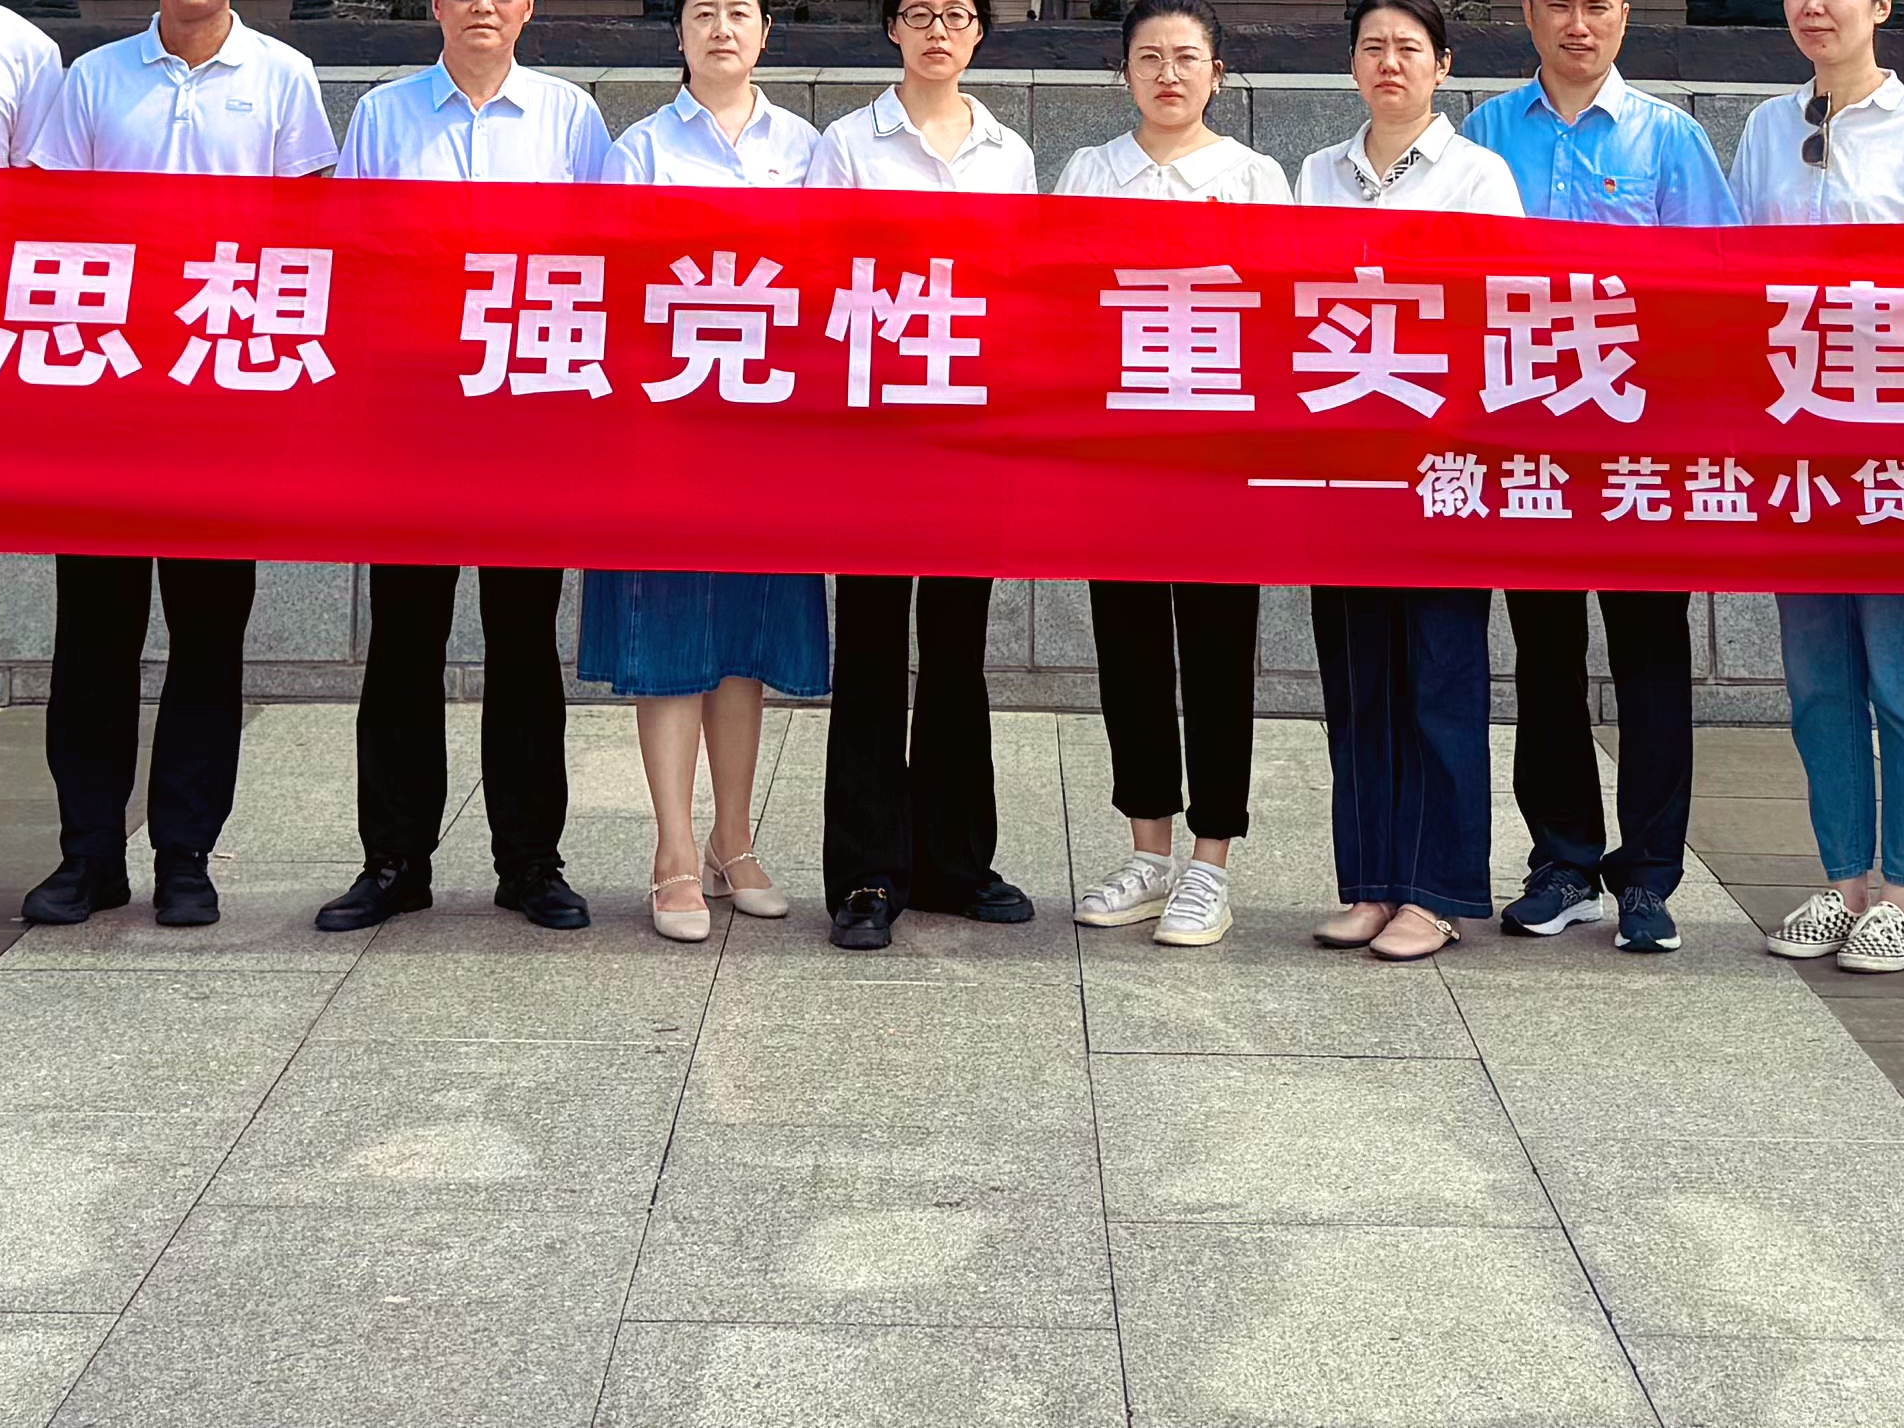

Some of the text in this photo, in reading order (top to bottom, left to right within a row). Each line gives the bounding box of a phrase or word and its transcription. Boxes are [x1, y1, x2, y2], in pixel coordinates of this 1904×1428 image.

[459, 251, 987, 407] 强党性
[1100, 265, 1646, 423] 重实践
